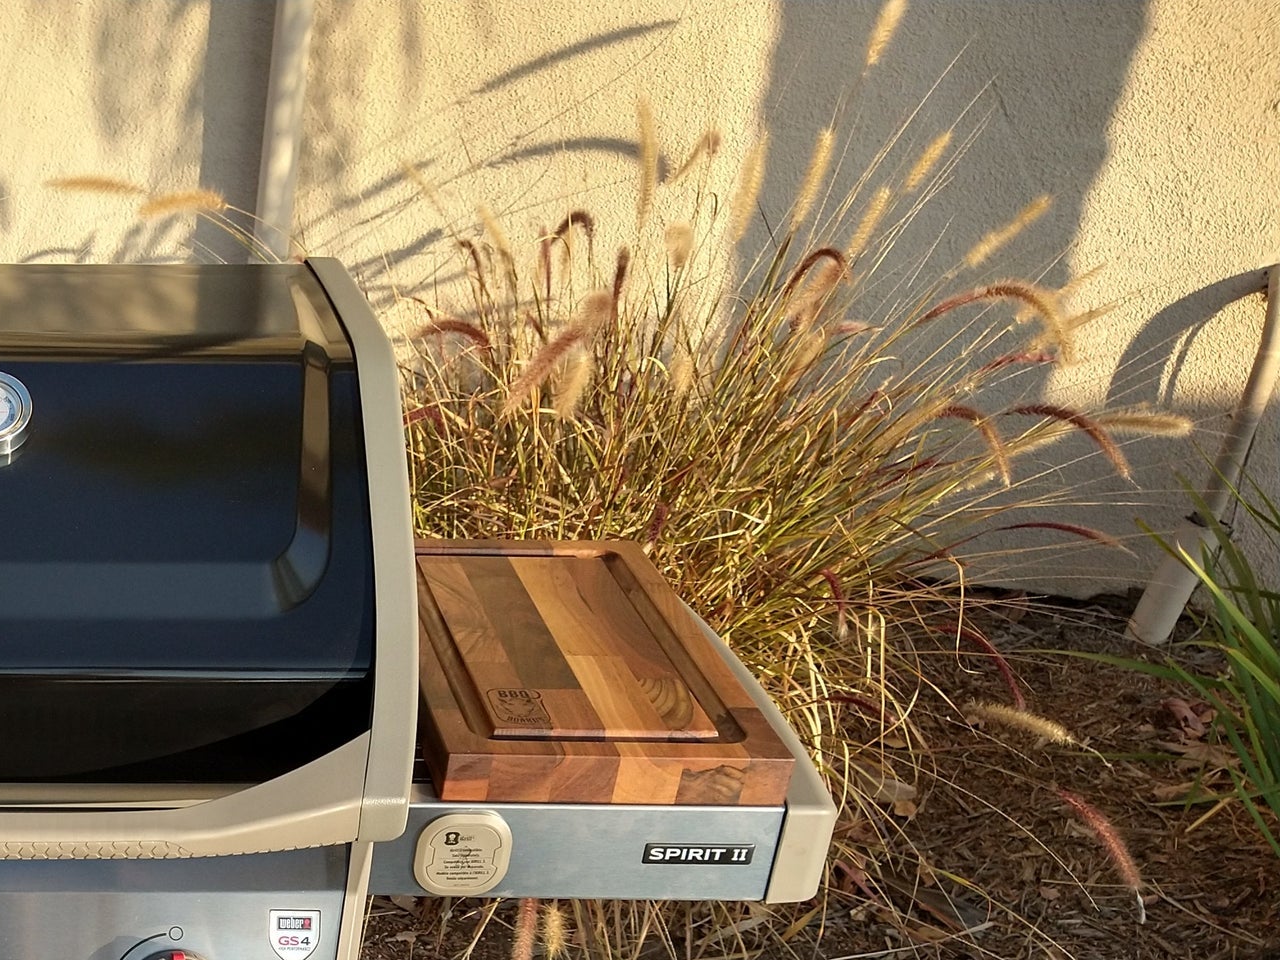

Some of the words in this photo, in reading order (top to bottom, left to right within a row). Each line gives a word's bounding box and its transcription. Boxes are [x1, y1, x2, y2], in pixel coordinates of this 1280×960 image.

[648, 847, 726, 861] SPIRIT
[731, 849, 748, 861] II
[279, 916, 304, 929] weber
